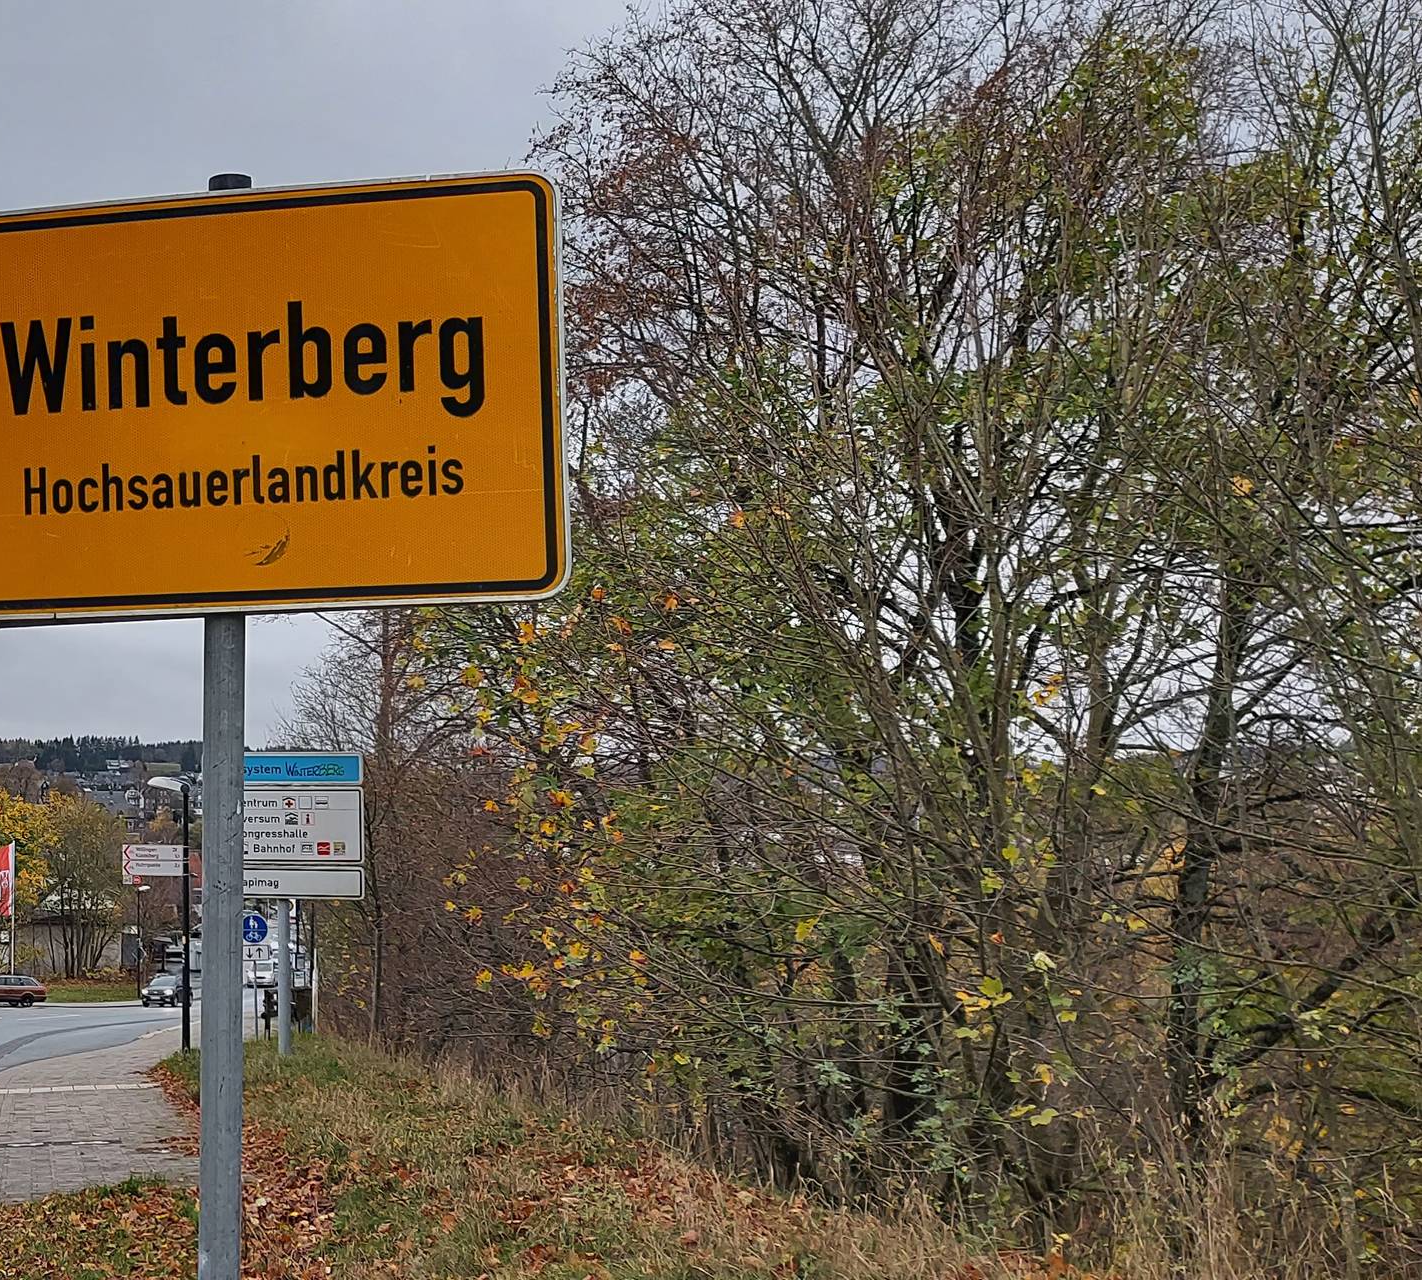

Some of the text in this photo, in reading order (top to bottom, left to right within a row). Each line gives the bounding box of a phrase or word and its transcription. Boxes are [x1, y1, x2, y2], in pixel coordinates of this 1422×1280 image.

[0, 301, 486, 418] Winterberg
[24, 446, 465, 516] Hochsauerlandkreis
[253, 844, 296, 854] Bahnhof
